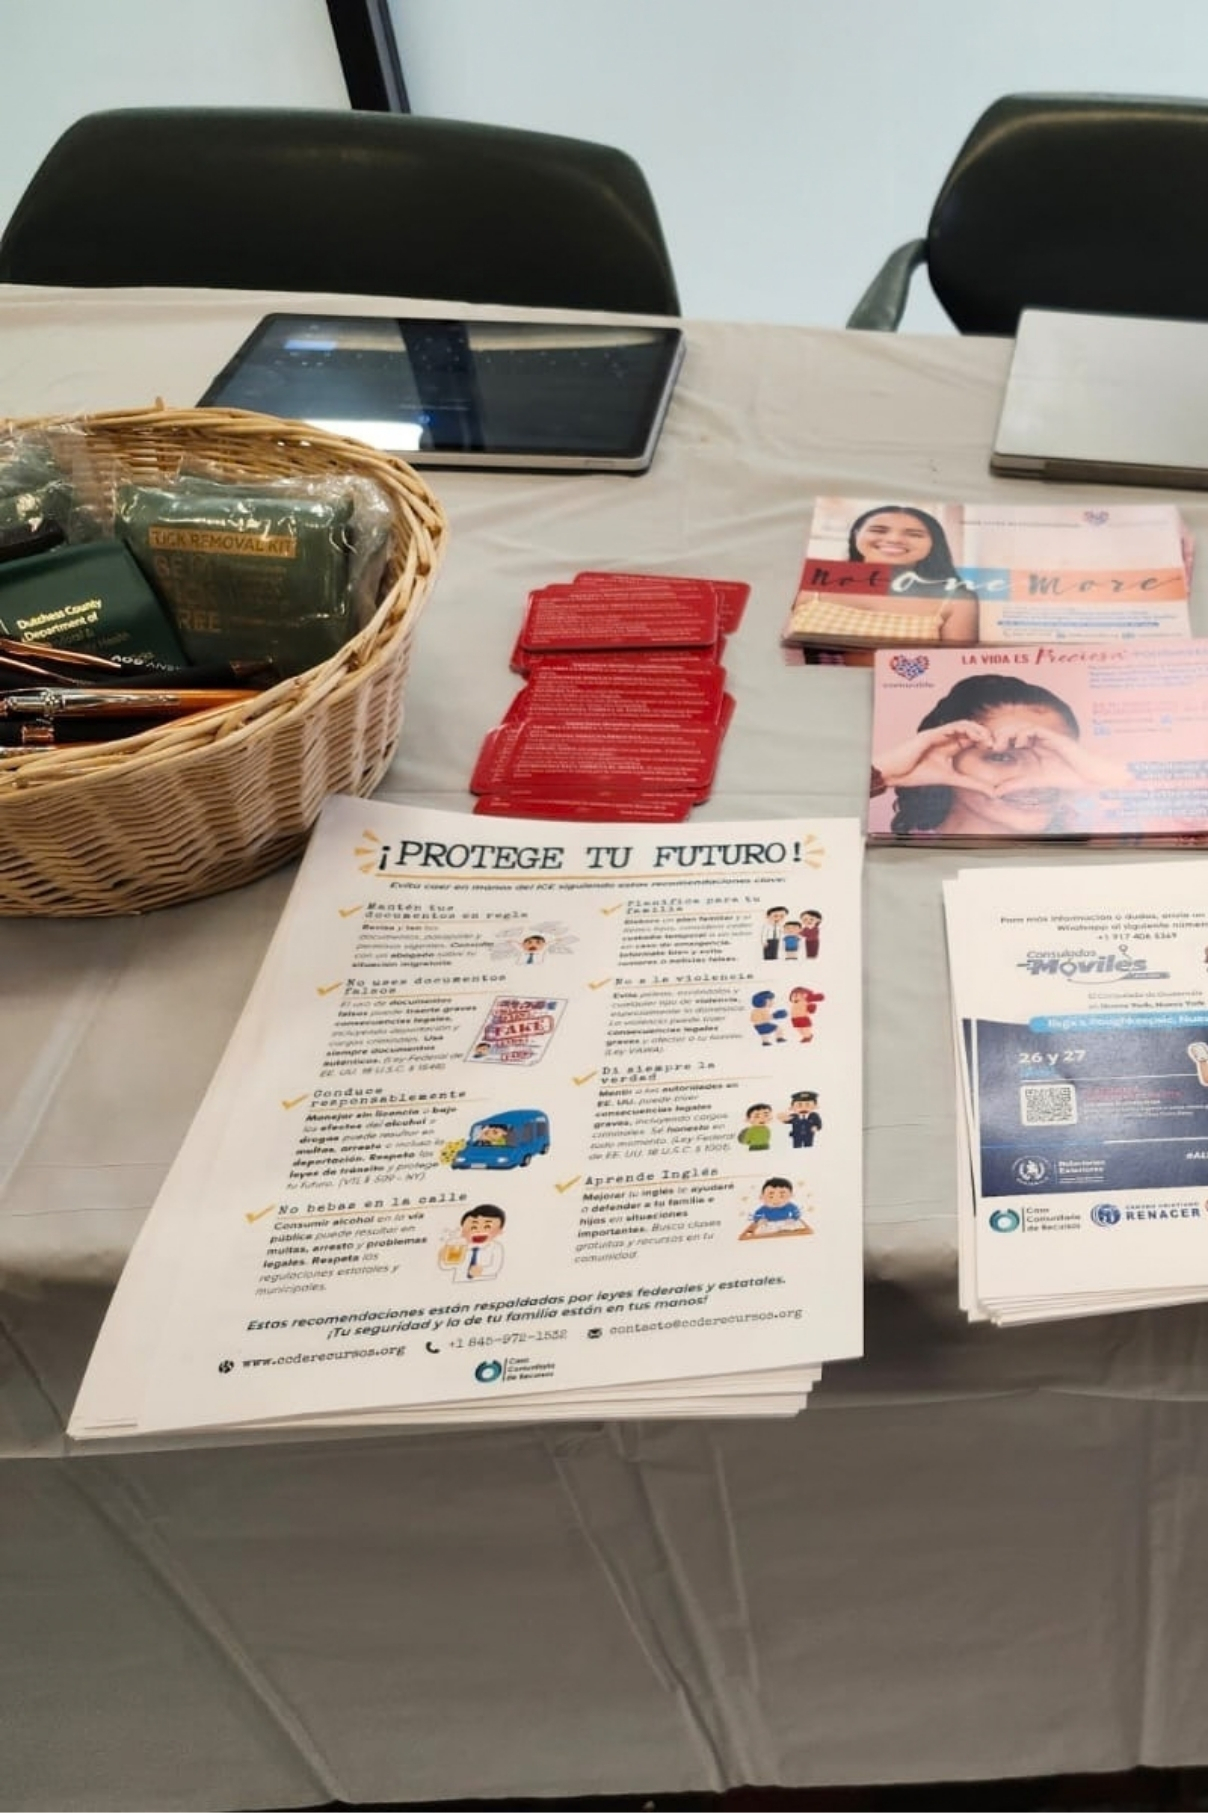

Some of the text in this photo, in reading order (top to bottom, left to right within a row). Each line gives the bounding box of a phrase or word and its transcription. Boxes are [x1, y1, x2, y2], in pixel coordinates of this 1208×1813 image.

[151, 531, 296, 555] TICK REMOVAL KIT
[16, 598, 103, 630] Dutchess County
[24, 617, 88, 640] Department
[87, 611, 99, 624] of
[962, 655, 978, 666] LA
[981, 653, 1010, 665] VIDA
[1014, 653, 1030, 664] ES
[378, 840, 803, 871] ¡PROTEGE TU FUTURO!
[366, 901, 454, 912] Mantén tus
[706, 896, 740, 907] para
[745, 894, 761, 903] tu
[364, 910, 529, 921] documentos en regla
[1026, 949, 1097, 960] Consulados
[347, 973, 507, 987] No uses documentos
[615, 977, 632, 986] No
[652, 975, 670, 985] la
[676, 972, 755, 984] violencia
[344, 986, 397, 997] falsos
[1018, 1049, 1087, 1066] 26 y 27
[601, 1060, 716, 1076] Di siempre la
[600, 1072, 657, 1085] verdad
[310, 1089, 467, 1109] responsablemente
[313, 1086, 384, 1099] Conduce
[584, 1166, 720, 1188] Aprende Inglés
[277, 1191, 468, 1216] No bebas en la calle
[1125, 1206, 1202, 1222] RENACER
[273, 1214, 375, 1231] Consumir alcohol
[366, 1235, 428, 1250] problemas
[247, 1274, 787, 1332] Estas recomendaciones están respaldadas por leyes federales y estatales.
[326, 1325, 352, 1341] ¡Tu
[353, 1316, 431, 1338] seguridad
[432, 1318, 443, 1332] y
[464, 1312, 484, 1326] de
[486, 1311, 503, 1324] tu
[504, 1305, 558, 1323] familia
[561, 1302, 603, 1317] están
[605, 1303, 625, 1315] en
[628, 1299, 651, 1312] tus
[654, 1294, 710, 1310] manos!
